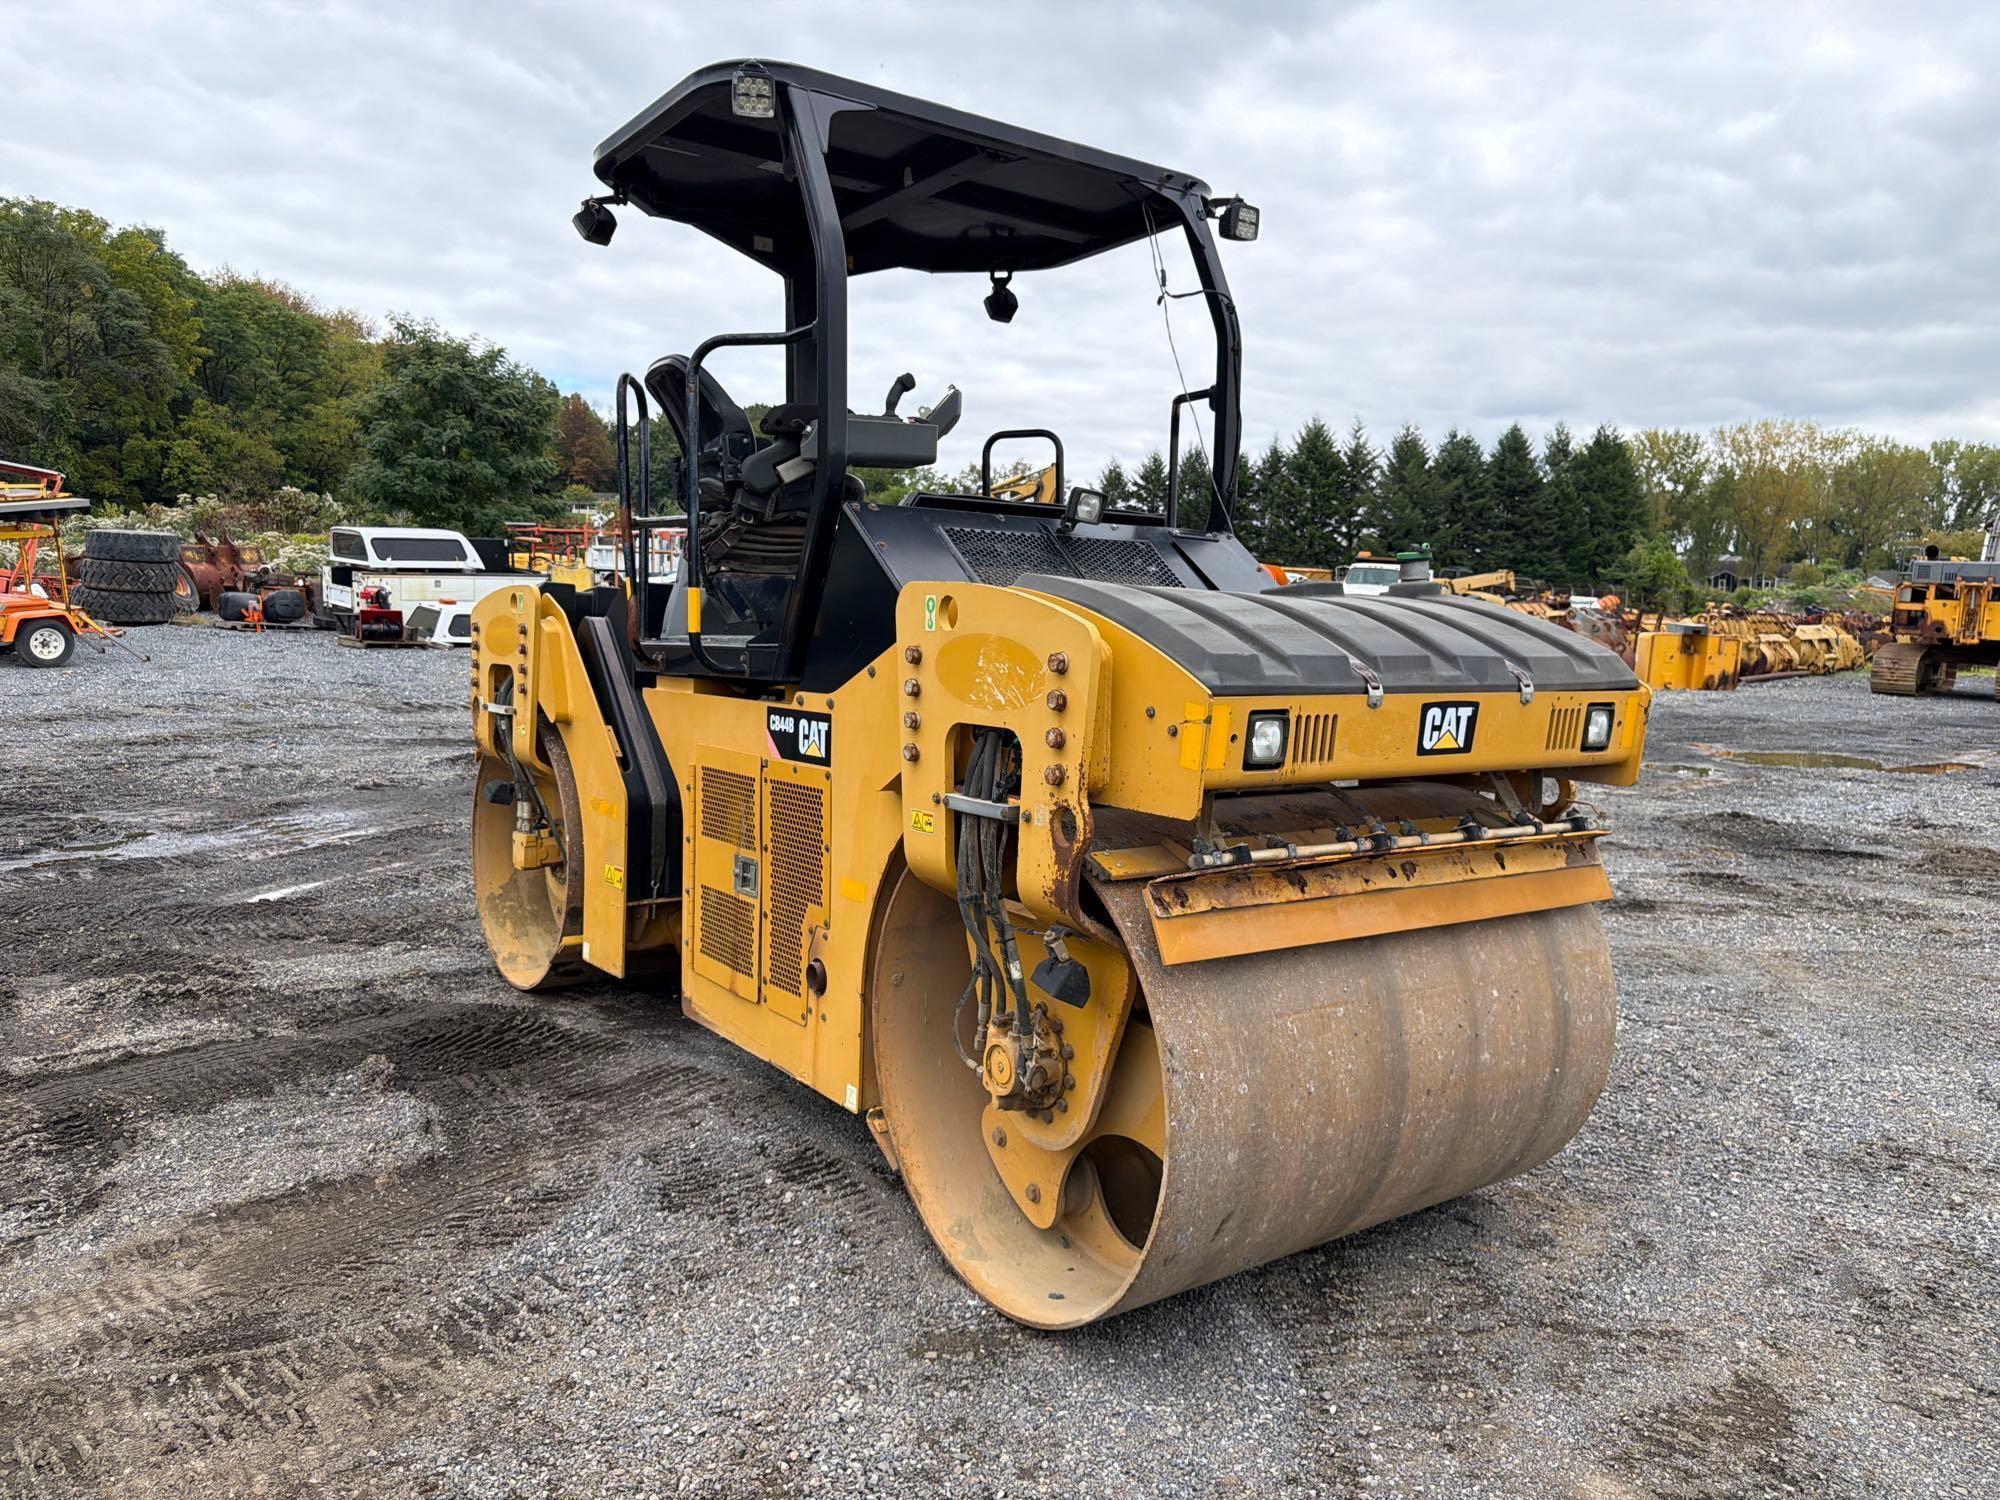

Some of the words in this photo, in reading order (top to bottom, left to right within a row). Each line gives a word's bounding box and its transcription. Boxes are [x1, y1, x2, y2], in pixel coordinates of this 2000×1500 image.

[769, 714, 795, 734] CB44B
[798, 718, 829, 759] CAT
[1422, 706, 1473, 750] CAT
